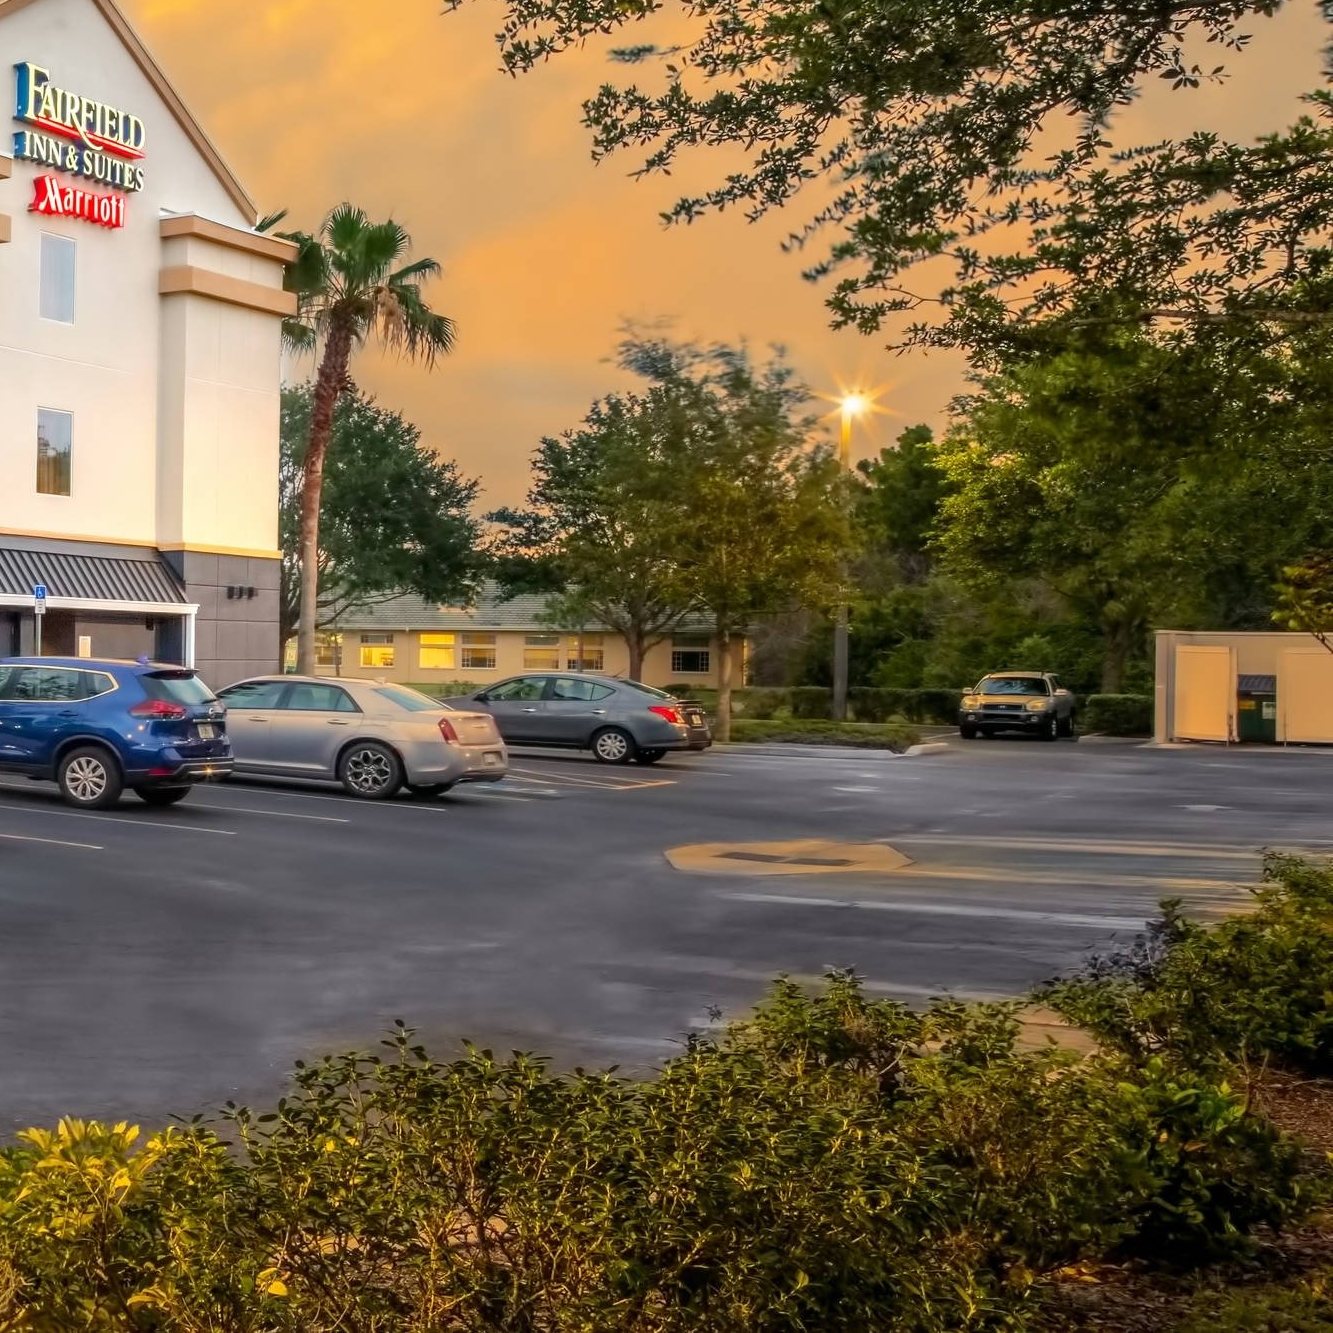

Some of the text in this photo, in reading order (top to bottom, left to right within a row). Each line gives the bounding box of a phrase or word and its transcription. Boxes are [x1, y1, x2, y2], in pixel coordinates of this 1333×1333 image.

[24, 62, 145, 150] FAIRFIELD
[23, 130, 145, 192] INN & SUITES
[37, 175, 125, 227] Marriott
